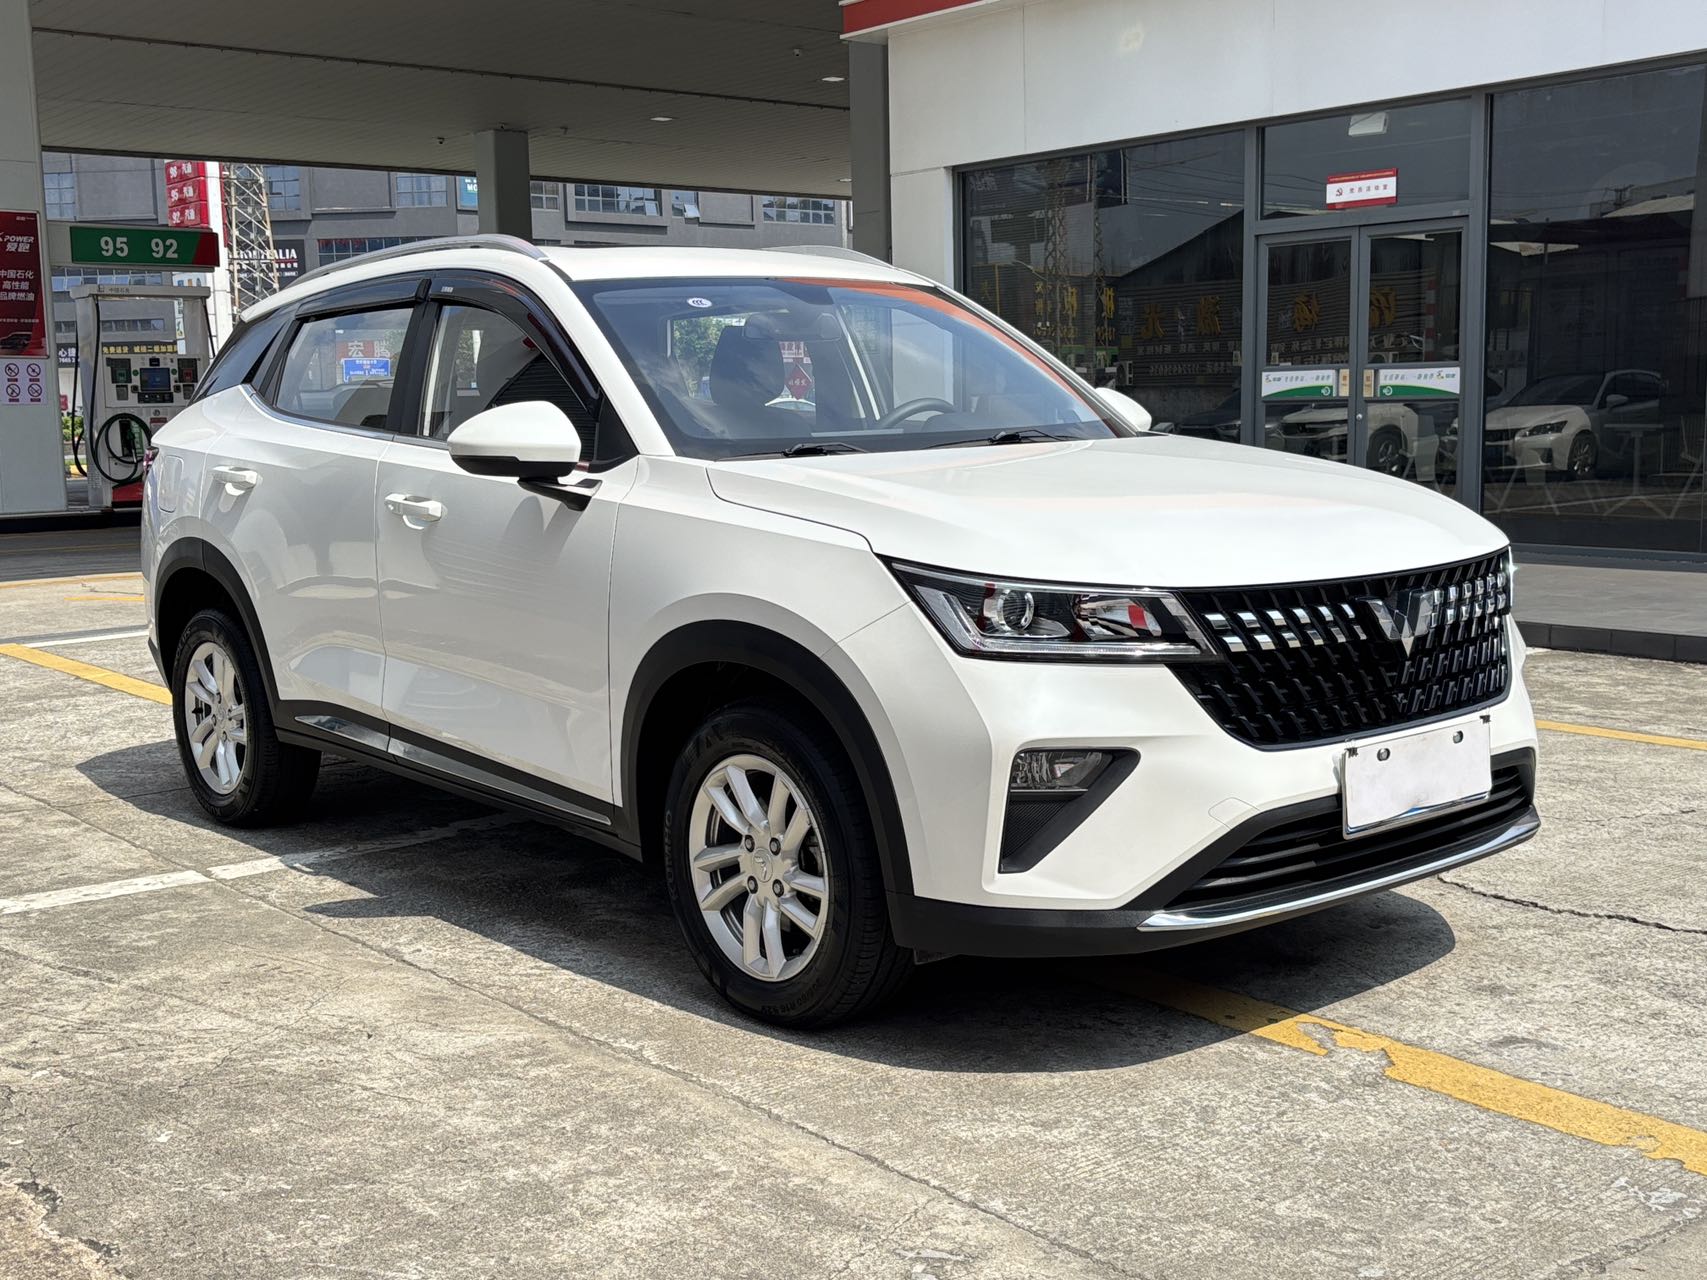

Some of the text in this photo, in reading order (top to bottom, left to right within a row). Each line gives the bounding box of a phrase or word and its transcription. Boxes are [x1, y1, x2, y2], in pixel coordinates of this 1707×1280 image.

[100, 236, 178, 258] 95 92
[0, 270, 34, 280] 中国石化
[2, 280, 30, 290] 高性能
